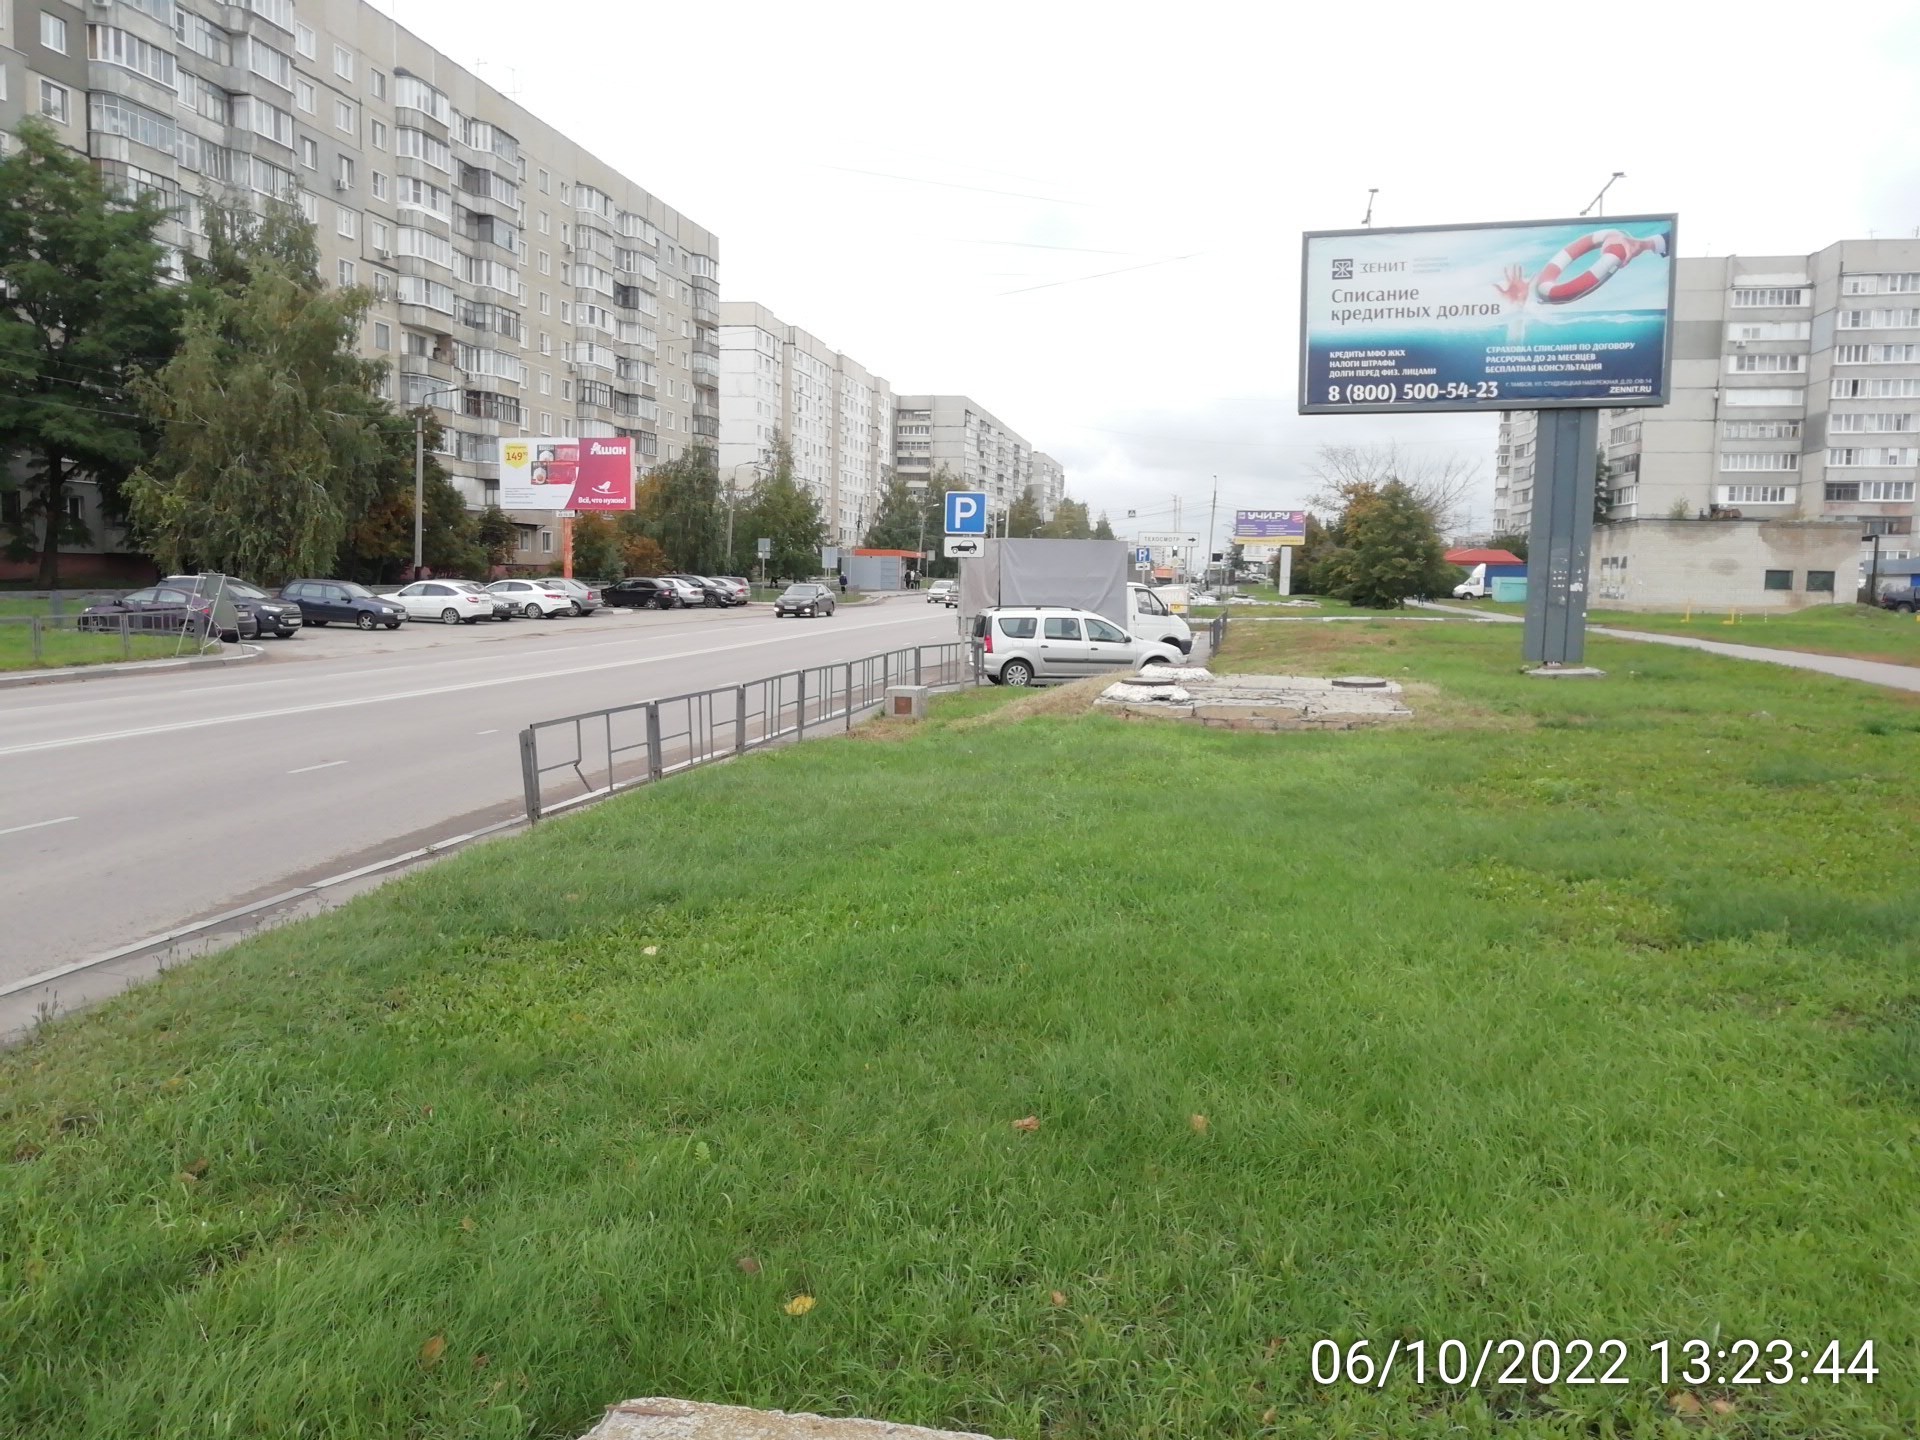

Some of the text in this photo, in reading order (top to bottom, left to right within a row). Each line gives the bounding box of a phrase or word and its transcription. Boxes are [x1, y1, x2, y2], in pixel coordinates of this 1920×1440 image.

[1359, 261, 1407, 273] ЗЕНИТ
[1331, 288, 1420, 303] Списание
[1331, 303, 1501, 325] кредитных долгов
[1486, 342, 1636, 354] СТРАХОВКА СПИСАНИЯ ПО ДОГОВОРУ
[1329, 349, 1406, 359] КРЕДИТЫ МФО ЖКХ
[1485, 355, 1532, 363] РАССРОЧКА
[1533, 355, 1546, 363] ДО
[1557, 353, 1596, 362] МЕСЯЦЕВ
[1329, 359, 1396, 368] НАЛОГИ ШТРАФЫ
[1485, 362, 1603, 373] БЕСПЛАТНАЯ КОНСУЛЬТАЦИЯ
[1329, 367, 1437, 378] ДОЛГИ ПЕРЕД ФИЗ. ЛИЦАМИ
[1328, 381, 1498, 403] 8 (800) 500-54-23
[1609, 385, 1652, 394] ZENNIT.RU
[590, 441, 627, 455] Ашан
[506, 451, 523, 461] 149
[578, 496, 591, 504] Всё,
[603, 496, 627, 505] нужно!
[955, 496, 977, 529] P
